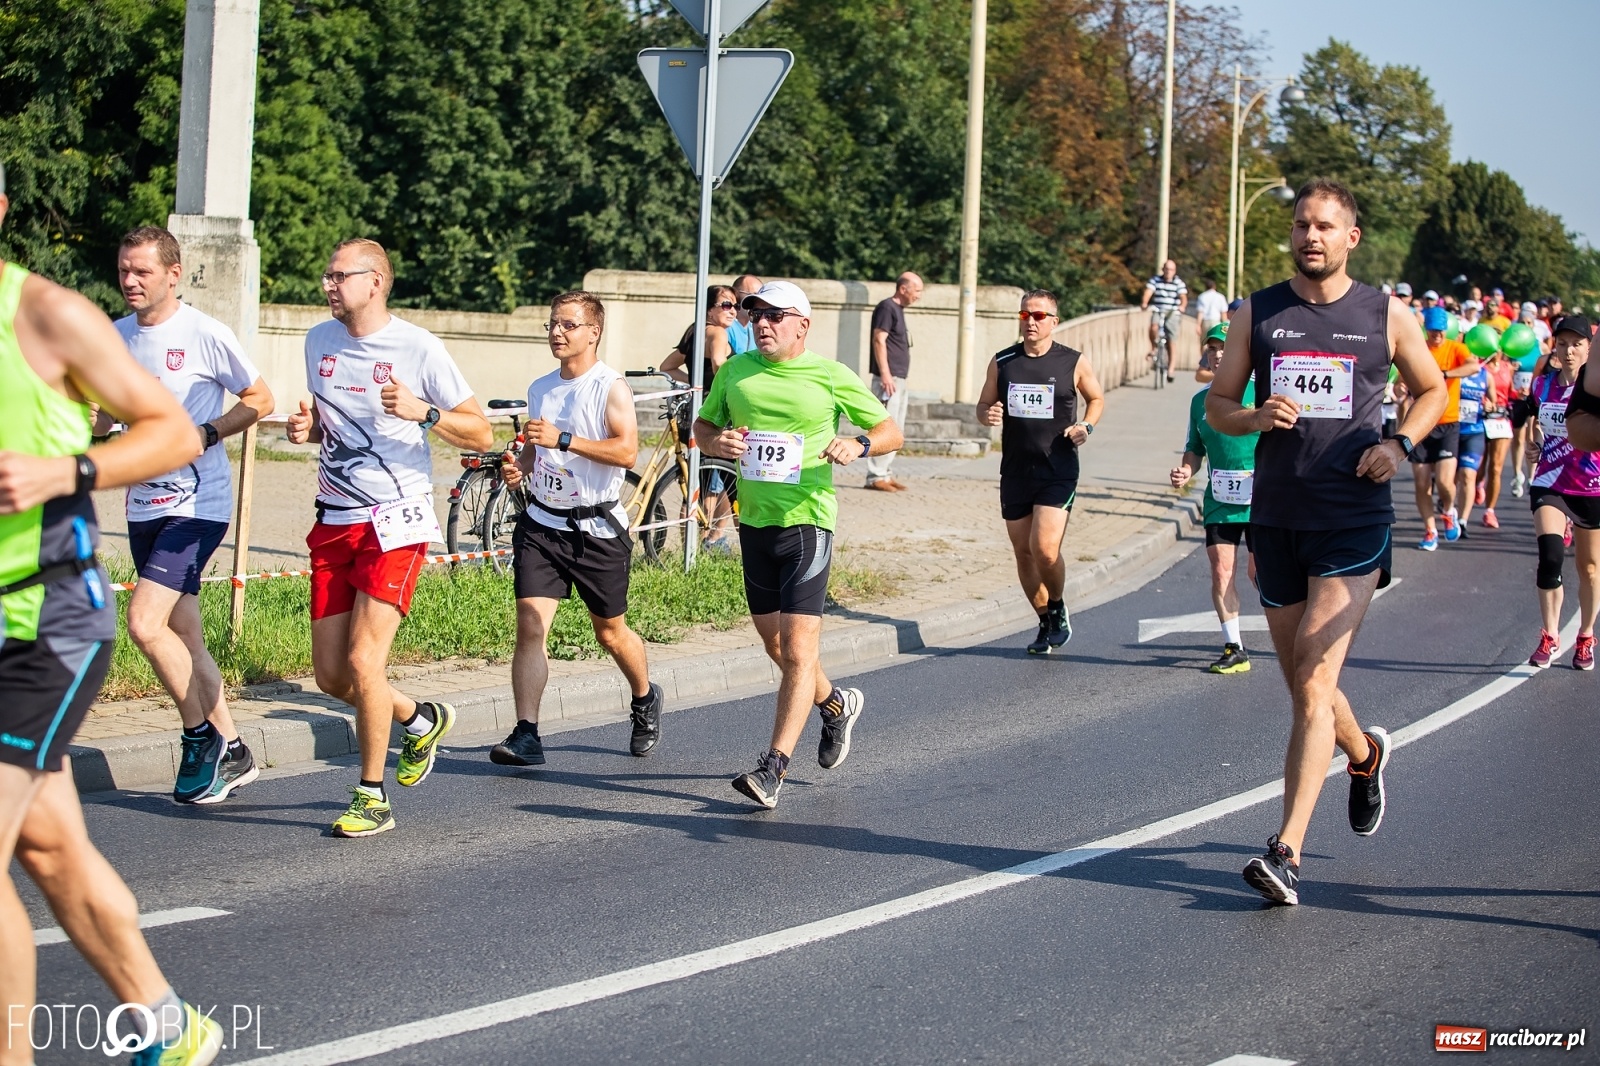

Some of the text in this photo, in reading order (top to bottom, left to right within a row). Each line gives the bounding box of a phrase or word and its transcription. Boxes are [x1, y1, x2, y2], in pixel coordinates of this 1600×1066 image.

[1294, 375, 1333, 394] 464
[1022, 393, 1043, 405] 144
[757, 444, 786, 462] 193
[544, 473, 563, 491] 173
[1228, 480, 1242, 491] 37
[402, 506, 424, 524] 55
